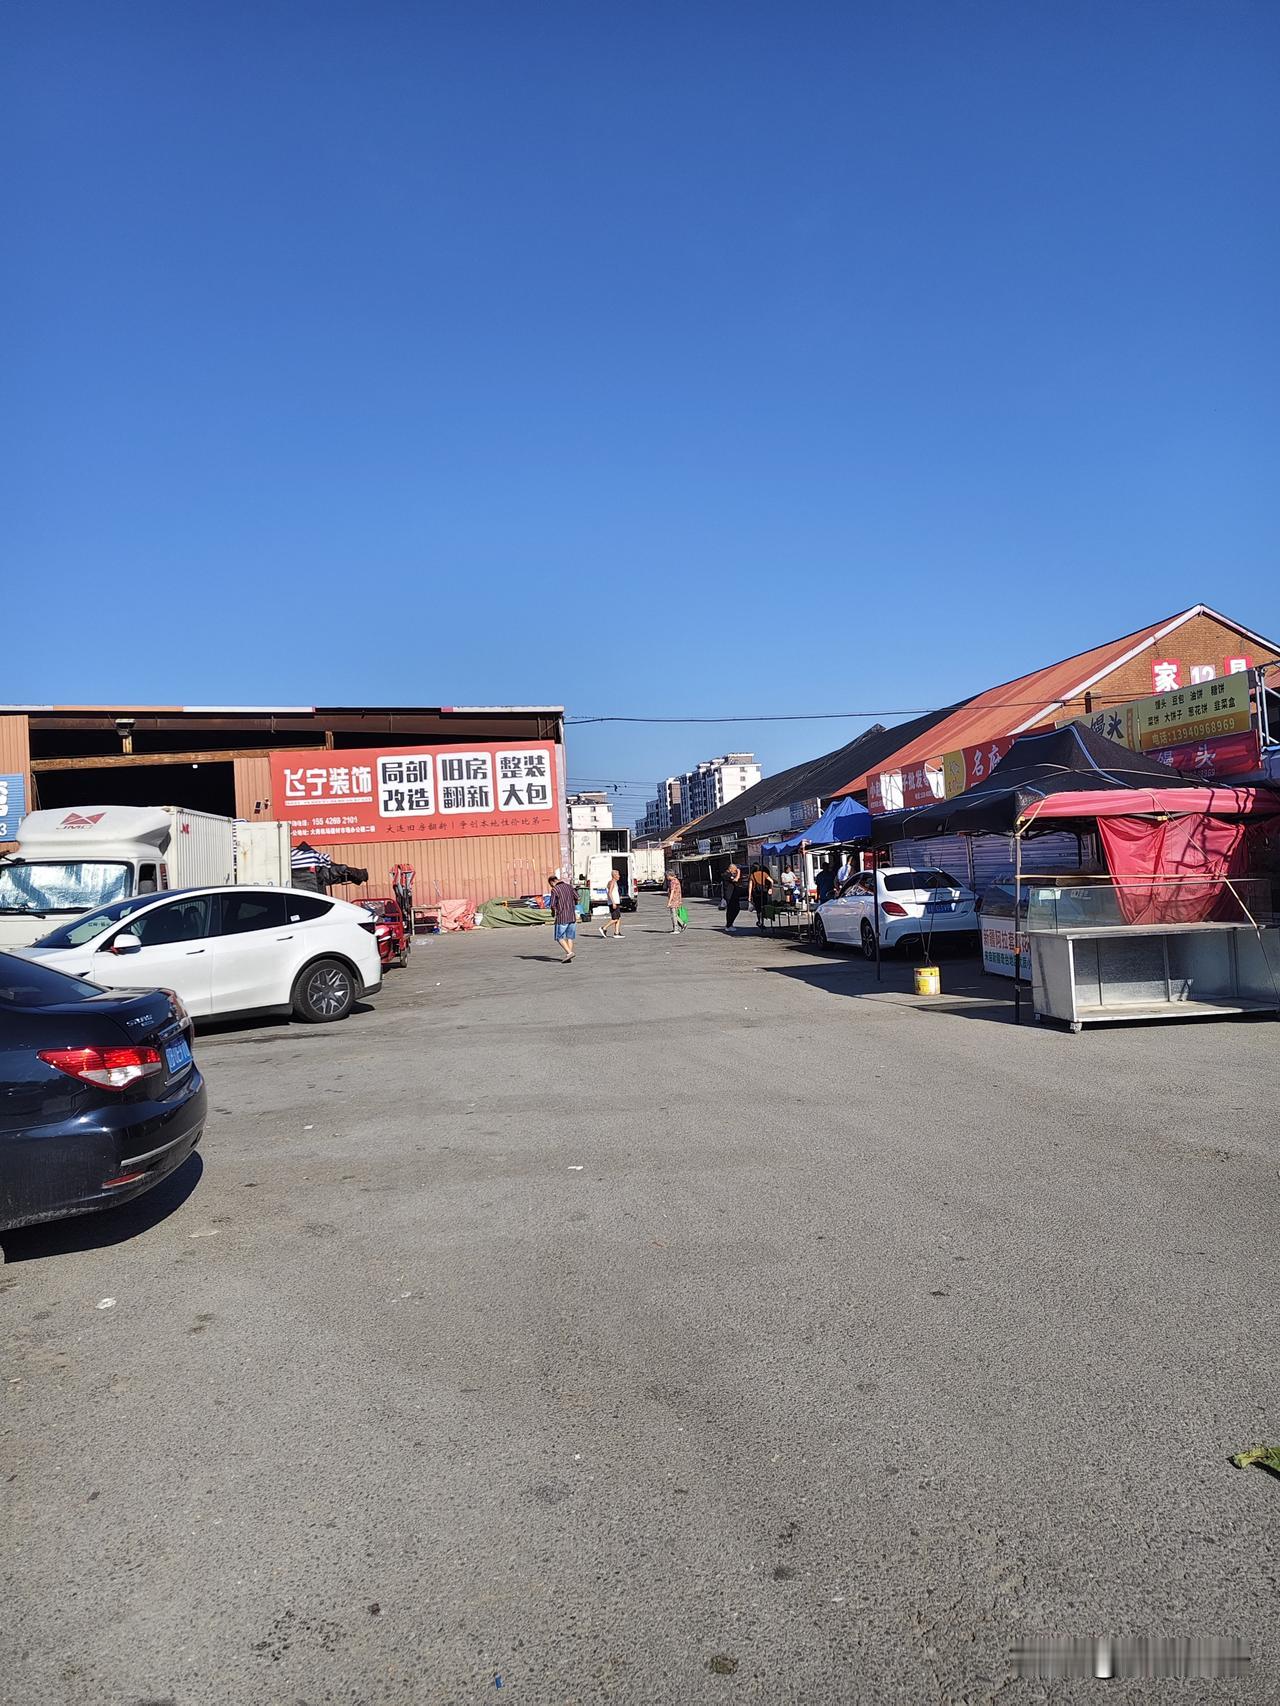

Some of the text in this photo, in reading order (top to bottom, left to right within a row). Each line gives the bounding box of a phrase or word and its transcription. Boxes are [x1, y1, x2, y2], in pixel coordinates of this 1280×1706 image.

[1154, 661, 1179, 692] 家
[1172, 694, 1185, 706] 豆包
[1210, 682, 1225, 696] 糖饼
[1164, 709, 1183, 723] 大饼子
[1214, 696, 1236, 711] 韭菜盒
[500, 754, 546, 779] 整装
[1194, 743, 1216, 768] 头
[381, 759, 428, 784] 局部
[441, 757, 489, 781] 旧房
[383, 787, 430, 812] 改造
[443, 784, 490, 809] 翻新
[502, 782, 548, 807] 大包
